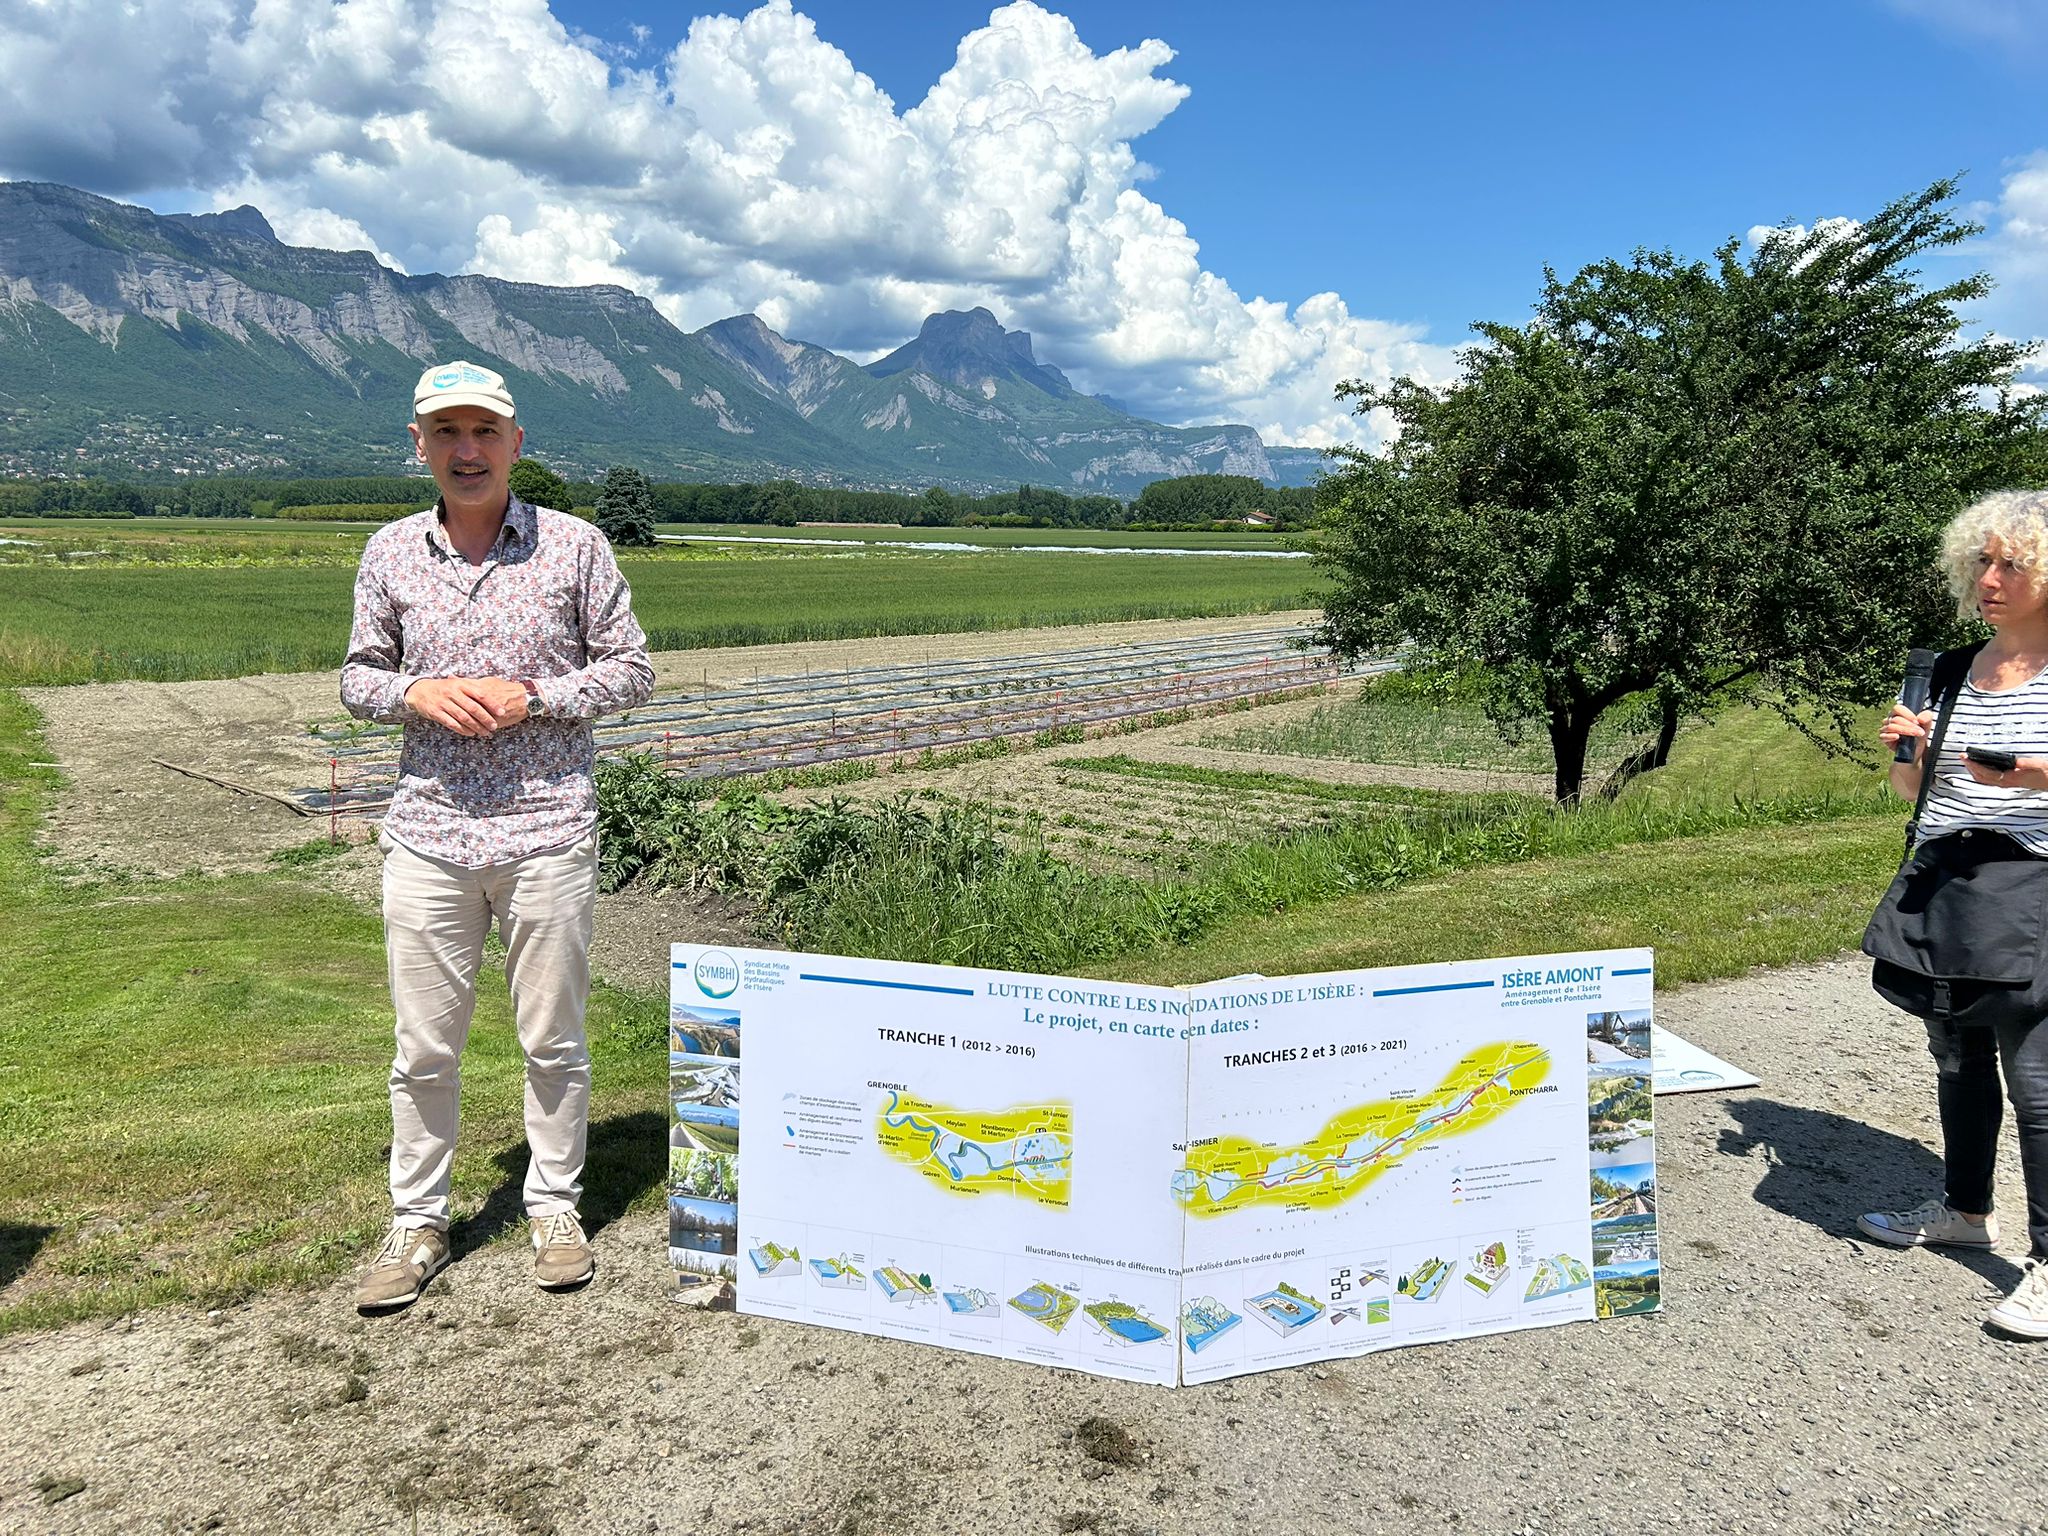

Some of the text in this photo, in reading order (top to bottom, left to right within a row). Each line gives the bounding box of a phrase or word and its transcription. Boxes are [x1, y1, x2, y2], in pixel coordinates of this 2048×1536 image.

[744, 960, 790, 970] Syndicat Mixte
[699, 964, 735, 981] SYMBHI
[756, 968, 780, 977] Bassins
[1502, 966, 1604, 989] ISÈRE AMONT
[744, 975, 785, 985] Hydrauliques
[987, 982, 1043, 1001] LUTTE
[1048, 988, 1120, 1008] CONTRE
[1125, 997, 1157, 1013] LES
[1271, 989, 1294, 1004] DE
[1505, 987, 1561, 999] Aménagement
[1564, 986, 1574, 994] de
[1501, 993, 1602, 1007] entre Grenoble et Pontcharra
[1023, 1007, 1045, 1024] Le
[1049, 1013, 1103, 1034] projet,
[1109, 1020, 1129, 1033] en
[1133, 1023, 1175, 1039] carte
[1210, 1018, 1250, 1034] dates
[878, 1028, 946, 1046] TRANCHE
[950, 1035, 956, 1048] 1
[961, 1040, 992, 1052] (2012
[1005, 1044, 1036, 1059] 2016)
[1223, 1048, 1297, 1068] TRANCHES
[1300, 1047, 1308, 1059] 2
[1312, 1047, 1325, 1058] et
[1329, 1044, 1336, 1056] 3
[1340, 1043, 1368, 1057] (2016
[1380, 1040, 1407, 1051] 2021)
[867, 1080, 908, 1091] GRENOBLE
[1509, 1085, 1558, 1097] PONTCHARRA
[946, 1120, 967, 1128] Meylan
[1025, 1245, 1071, 1259] Illustrations
[1072, 1252, 1115, 1266] techniques
[1116, 1259, 1127, 1268] de
[1128, 1261, 1167, 1274] différents
[1195, 1262, 1223, 1272] réalisés
[1224, 1258, 1242, 1267] dans
[1242, 1256, 1250, 1264] le
[1251, 1253, 1271, 1263] cadre
[1272, 1251, 1282, 1259] du
[1283, 1248, 1305, 1259] projet
